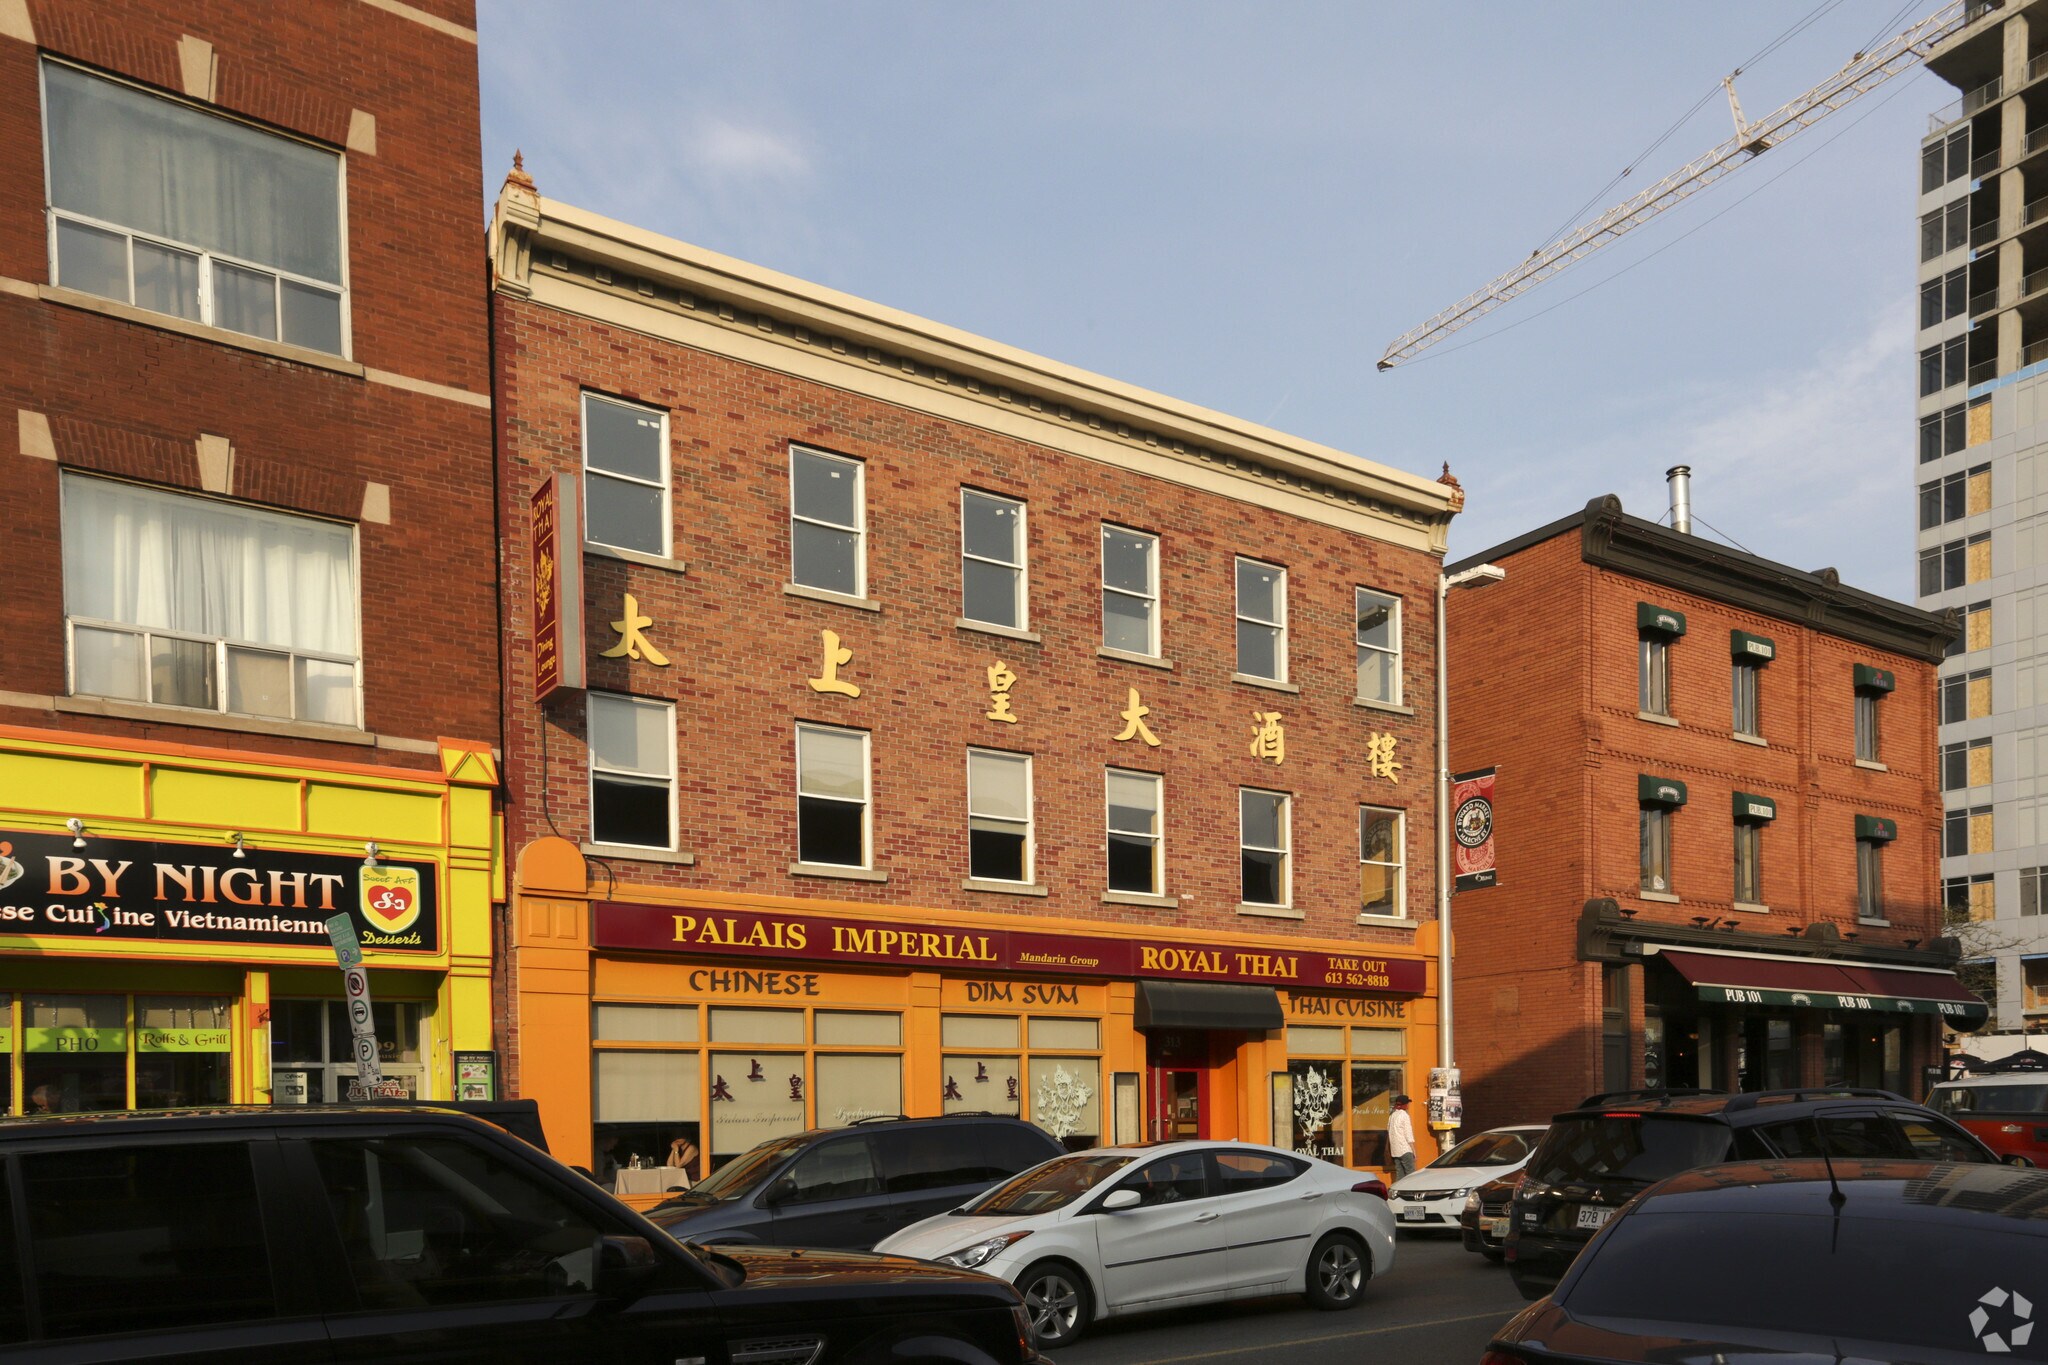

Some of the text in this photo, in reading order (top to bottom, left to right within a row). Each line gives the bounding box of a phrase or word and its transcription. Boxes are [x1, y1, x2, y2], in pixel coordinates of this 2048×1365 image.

[533, 489, 552, 522] ROYAL
[533, 509, 552, 542] THAI
[537, 637, 553, 658] Dining
[538, 655, 556, 677] Lounge
[45, 855, 344, 910] BY NIGHT
[360, 930, 422, 945] Desserts
[671, 915, 997, 962] PALAIS IMPERIAL
[1020, 952, 1099, 967] Mandarin Group
[1141, 946, 1298, 978] ROYAL THAI
[1328, 957, 1387, 973] TAKE OUT
[689, 969, 820, 997] CHINESE
[1325, 972, 1389, 987] 613 562-8818
[965, 981, 1079, 1005] DIM SUM
[1725, 988, 1762, 1003] PUB 101
[1838, 996, 1872, 1009] PUB 101
[1288, 996, 1407, 1018] THAI CUISINE
[1937, 1002, 1954, 1014] PUB
[178, 1034, 189, 1045] &
[195, 1033, 227, 1046] Grill
[1580, 1211, 1598, 1223] 378
